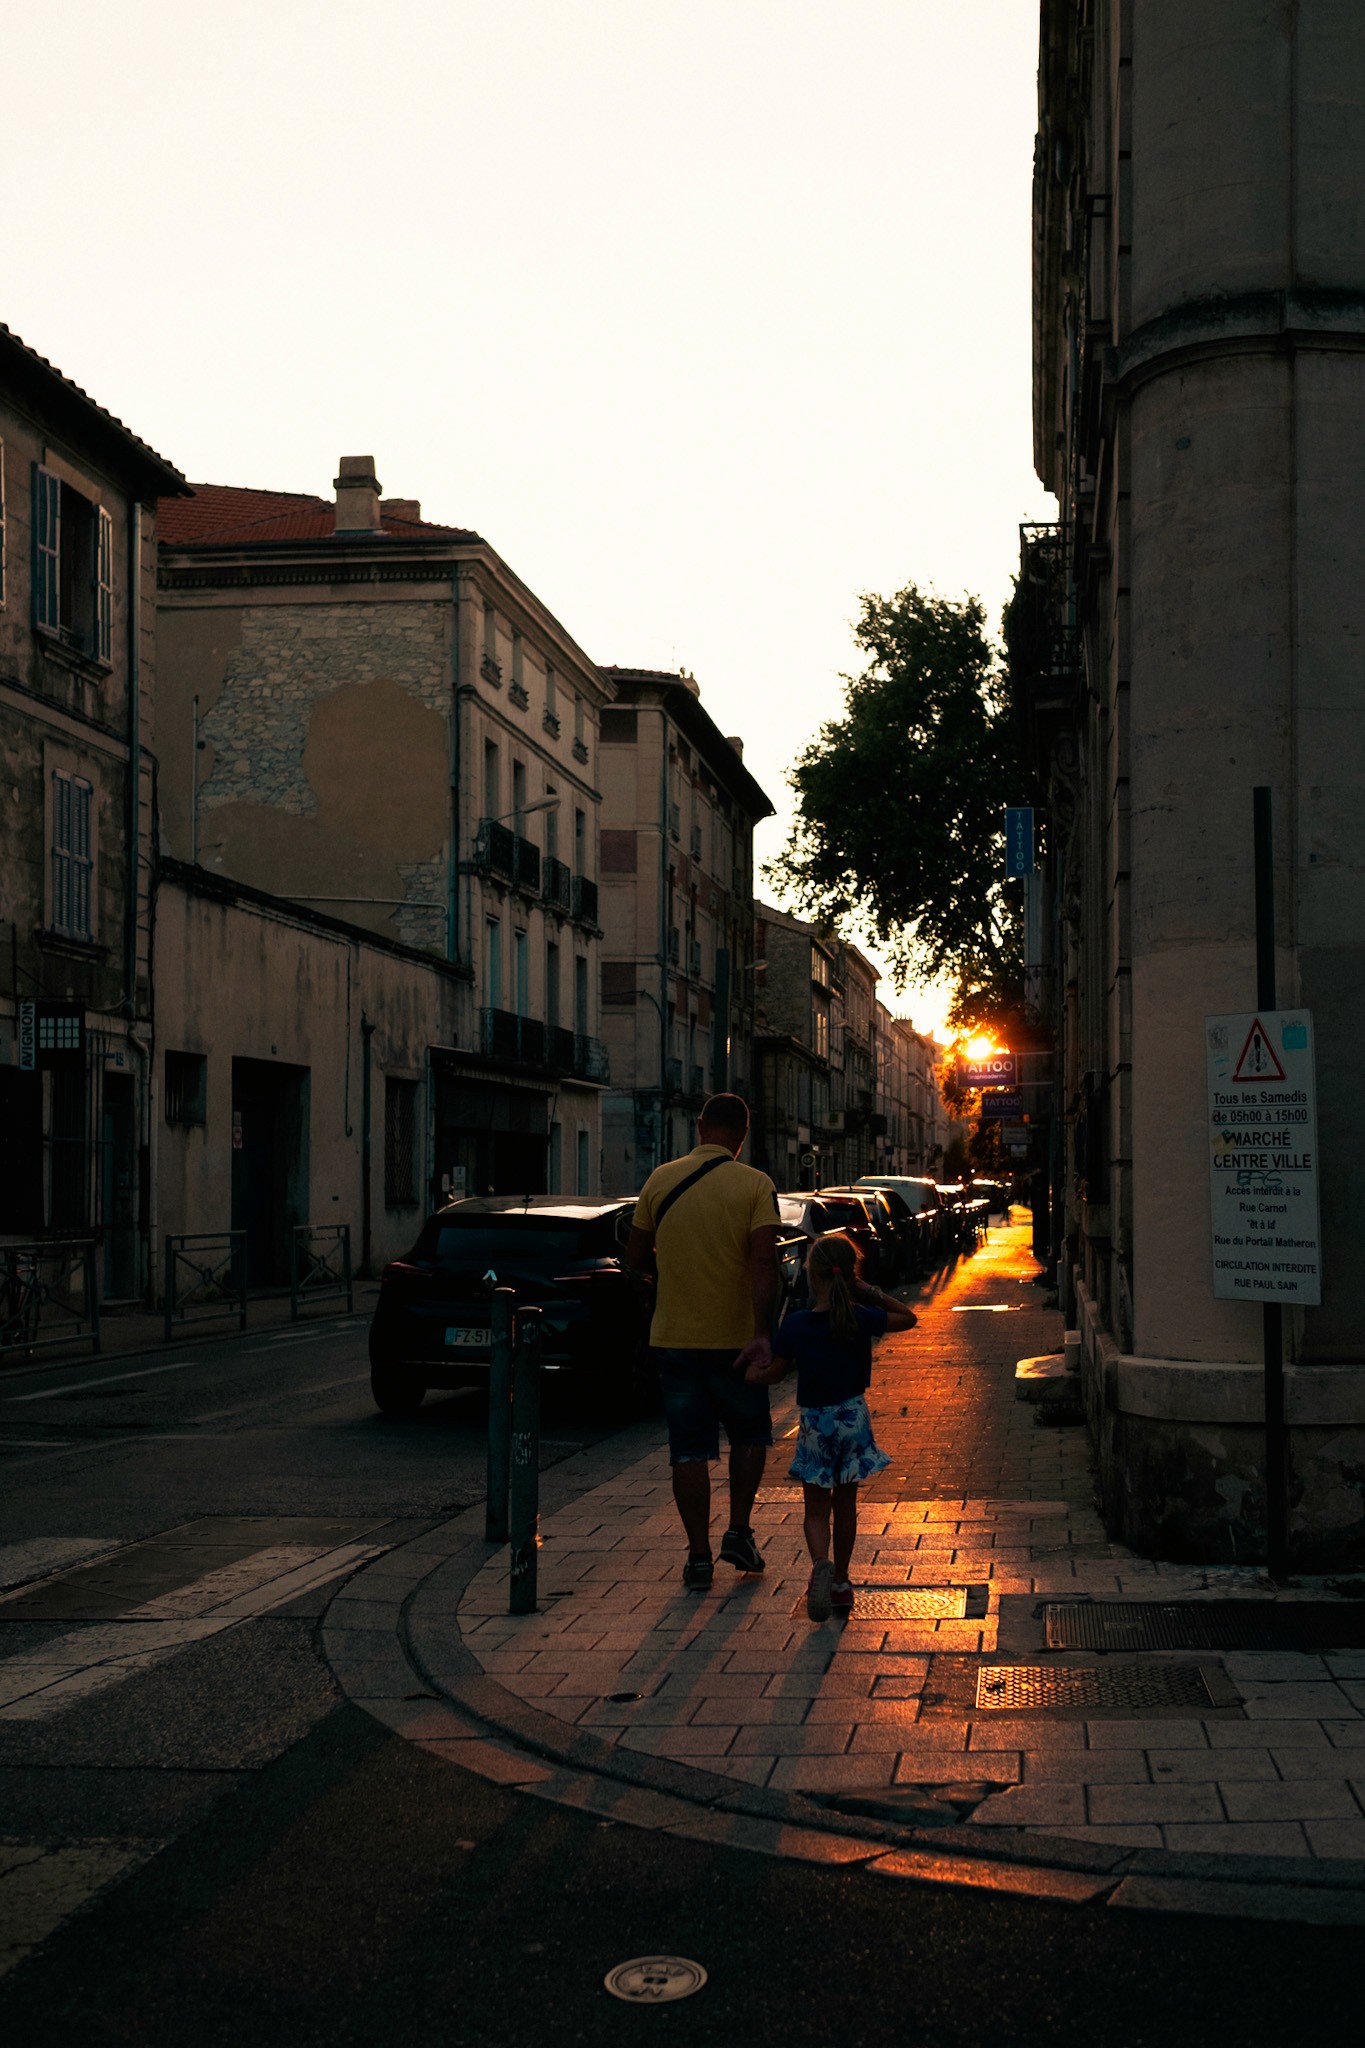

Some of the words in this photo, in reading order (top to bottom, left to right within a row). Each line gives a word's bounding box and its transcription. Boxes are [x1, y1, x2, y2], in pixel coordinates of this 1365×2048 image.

[1015, 811, 1025, 871] TATTOO
[21, 1004, 33, 1068] AVIGNON
[961, 1060, 1013, 1073] TATTOO
[984, 1096, 1020, 1107] TATTOO
[1213, 1092, 1239, 1105] Tous
[1241, 1091, 1257, 1104] les
[1260, 1090, 1308, 1104] Samedis
[1213, 1111, 1228, 1123] de
[1230, 1110, 1262, 1122] 05h00
[1265, 1110, 1272, 1122] à
[1275, 1108, 1308, 1121] 15h00
[1231, 1127, 1291, 1146] MARCHÉ
[1213, 1153, 1268, 1169] CENTRE
[1271, 1153, 1312, 1169] VILLE
[1225, 1185, 1251, 1196] Accès
[1253, 1185, 1283, 1196] interdit
[1285, 1185, 1291, 1196] à
[1293, 1185, 1301, 1197] la
[1239, 1202, 1256, 1212] Rue
[1258, 1202, 1288, 1213] Carnot
[1259, 1219, 1265, 1230] à
[1267, 1219, 1276, 1230] la
[1214, 1235, 1231, 1245] Rue
[1232, 1235, 1243, 1245] du
[1245, 1236, 1273, 1247] Portail
[1275, 1237, 1317, 1249] Matheron
[1215, 1259, 1270, 1272] CIRCULATION
[1272, 1262, 1317, 1274] INTERDITE
[1234, 1278, 1251, 1288] RUE
[1253, 1279, 1276, 1290] PAUL
[1277, 1280, 1299, 1291] SAIN
[454, 1329, 489, 1344] FZ-51
